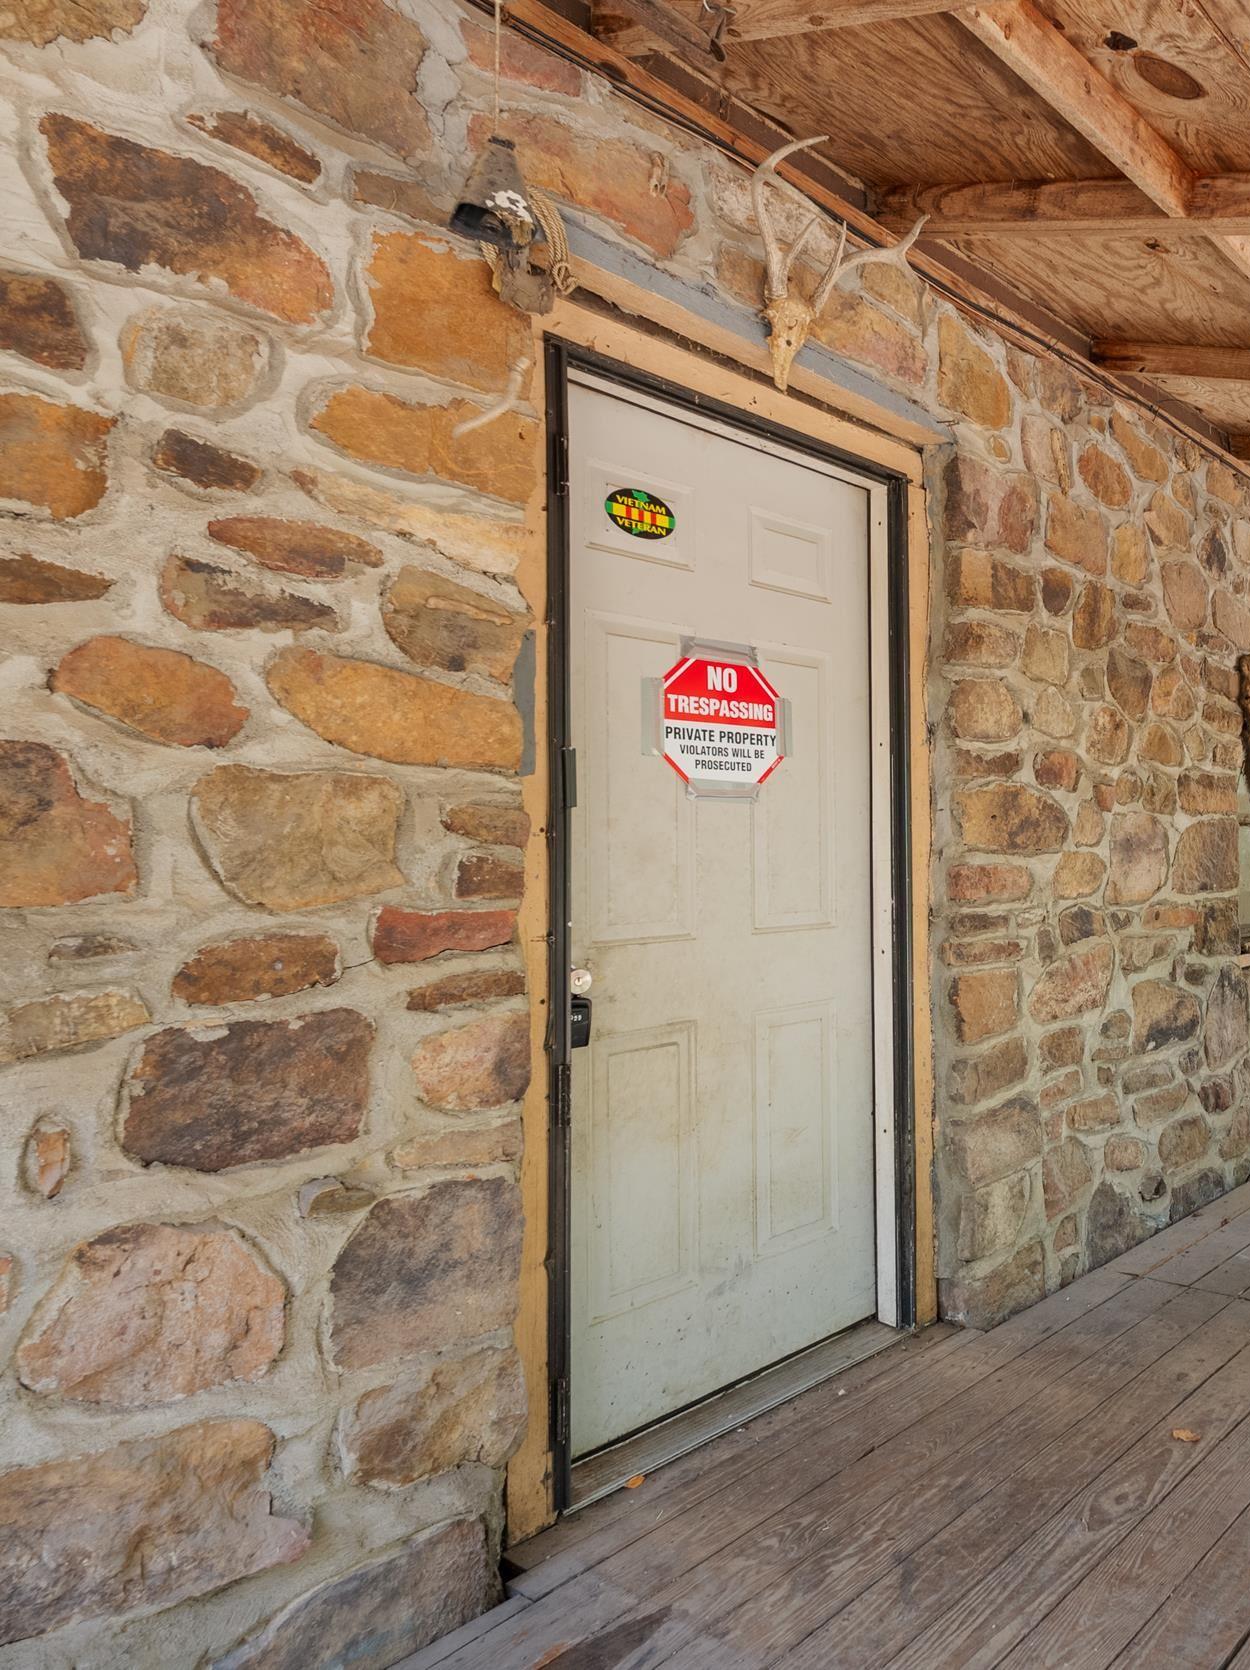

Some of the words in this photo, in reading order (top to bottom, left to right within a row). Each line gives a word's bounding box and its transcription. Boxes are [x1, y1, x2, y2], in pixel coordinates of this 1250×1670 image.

[616, 495, 666, 515] VIETNAM
[616, 517, 666, 536] VETERAN
[707, 665, 737, 693] NO
[667, 694, 773, 721] TRESPASSING
[665, 726, 715, 742] PRIVATE
[719, 731, 776, 746] PROPERTY
[680, 745, 729, 757] VIOLATORS
[732, 748, 752, 759] WILL
[754, 750, 765, 759] BE
[695, 760, 752, 772] PROSECUTED
